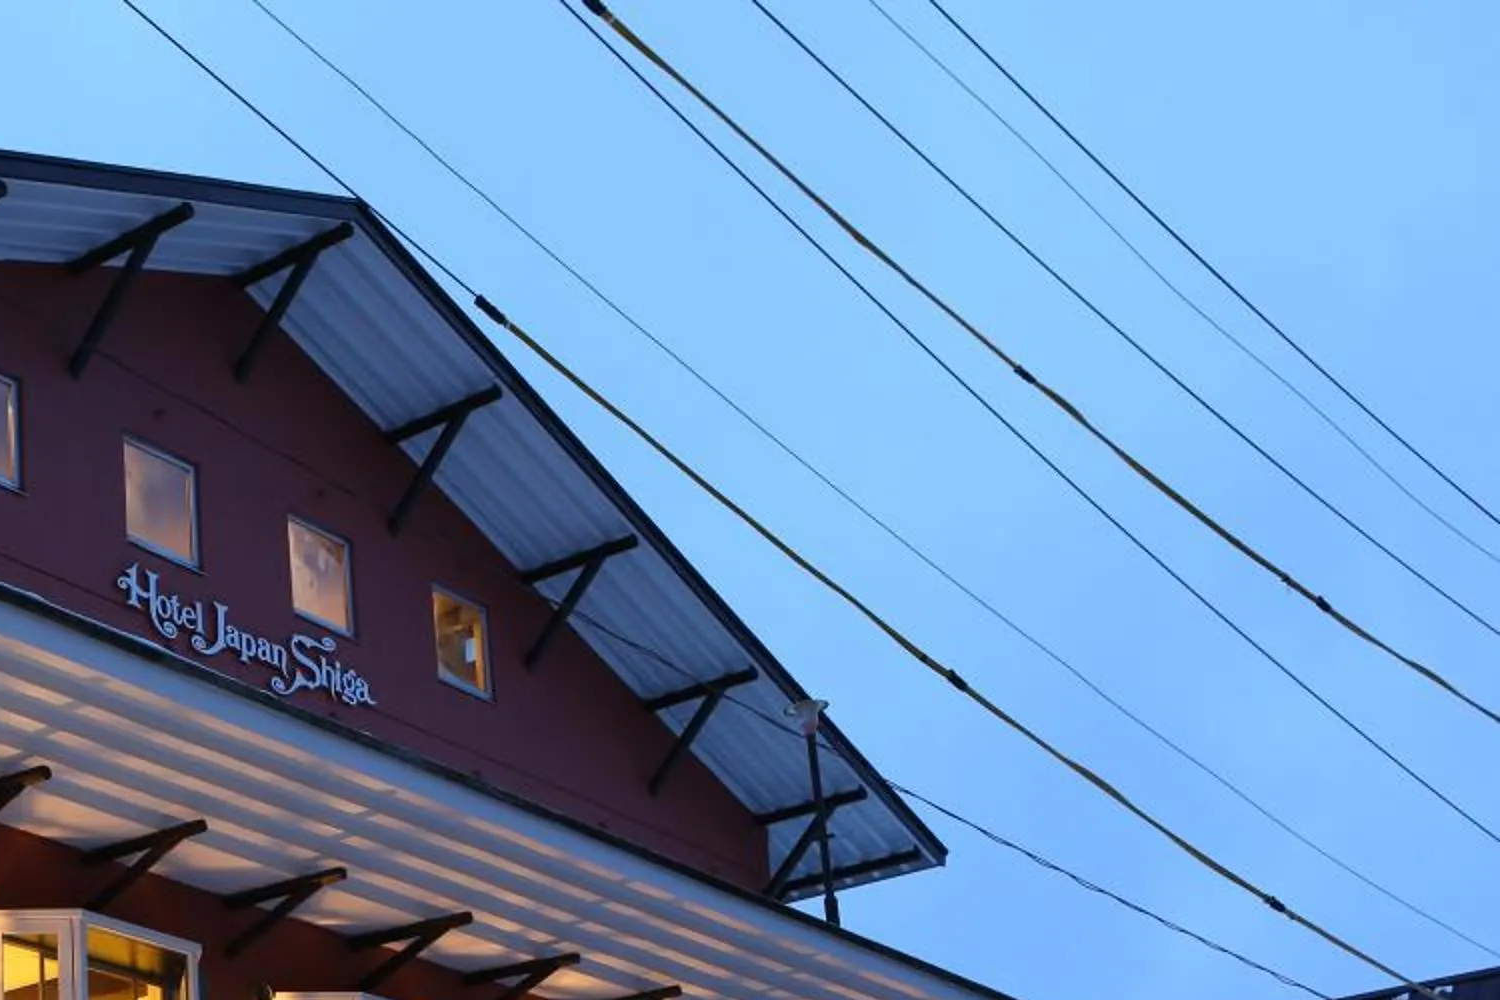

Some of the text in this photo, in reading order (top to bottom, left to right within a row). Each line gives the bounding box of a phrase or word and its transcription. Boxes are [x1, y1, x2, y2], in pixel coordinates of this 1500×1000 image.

[117, 562, 377, 705] Hotel Japan Shiga
